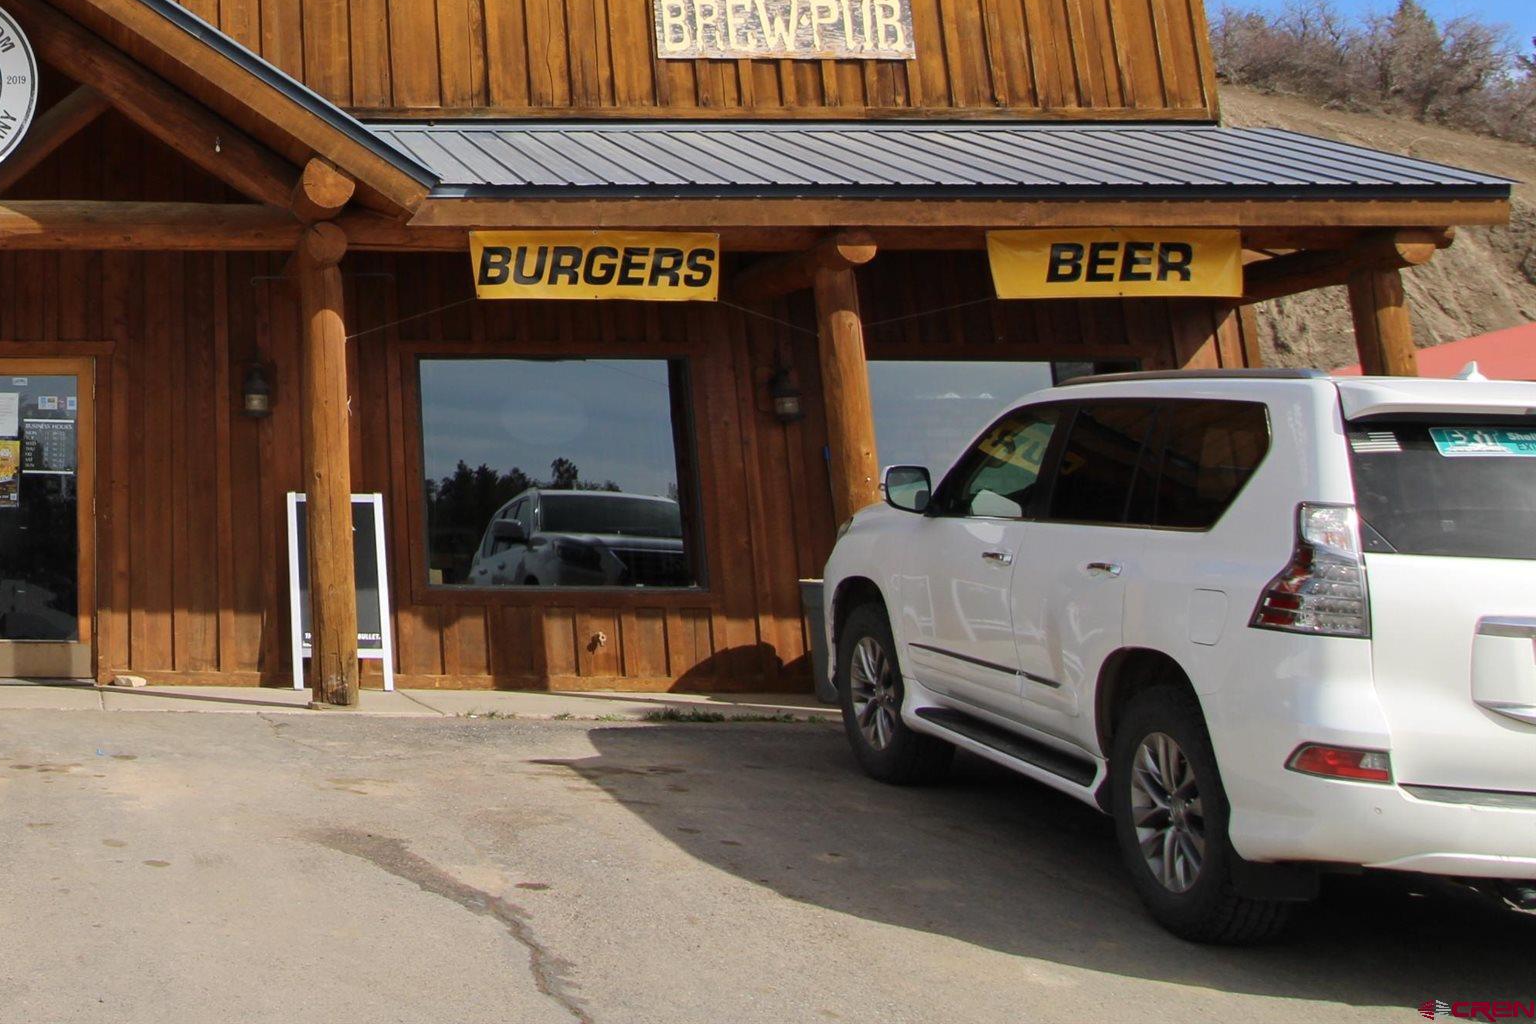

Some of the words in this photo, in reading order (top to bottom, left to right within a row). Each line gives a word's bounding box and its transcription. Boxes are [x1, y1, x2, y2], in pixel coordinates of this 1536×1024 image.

[6, 76, 27, 85] 2019
[478, 246, 715, 288] BURGERS
[1046, 241, 1193, 283] BEER
